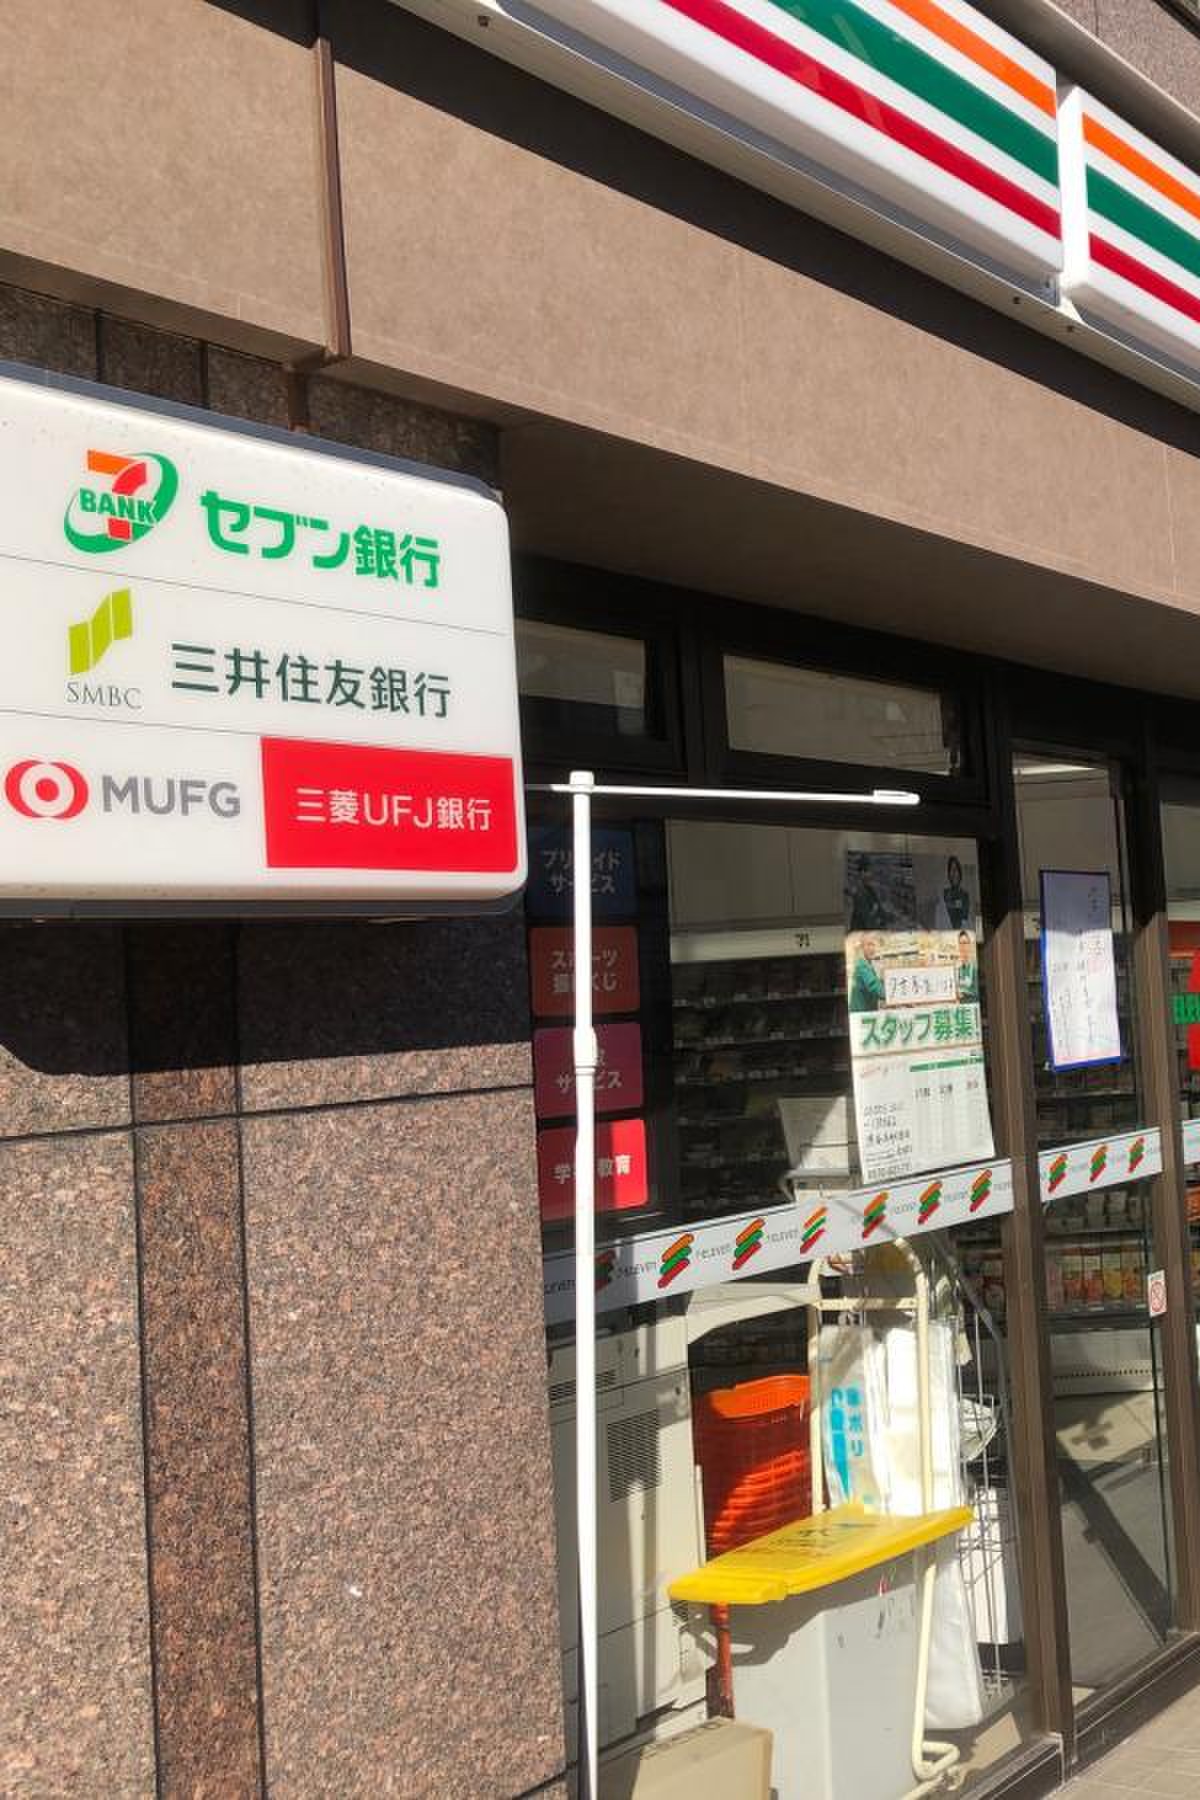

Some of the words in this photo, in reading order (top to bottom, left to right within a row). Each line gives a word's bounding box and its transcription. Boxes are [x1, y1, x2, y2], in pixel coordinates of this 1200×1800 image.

[79, 487, 159, 524] BANK
[200, 489, 441, 589] セブン銀行
[66, 680, 142, 711] SMBC
[171, 641, 451, 719] 三井住友銀行
[102, 775, 241, 819] MUFG
[296, 786, 491, 832] 三菱UFJ銀行
[543, 848, 621, 870] プリイド
[551, 873, 615, 894] サビス
[556, 1070, 622, 1095] サビス
